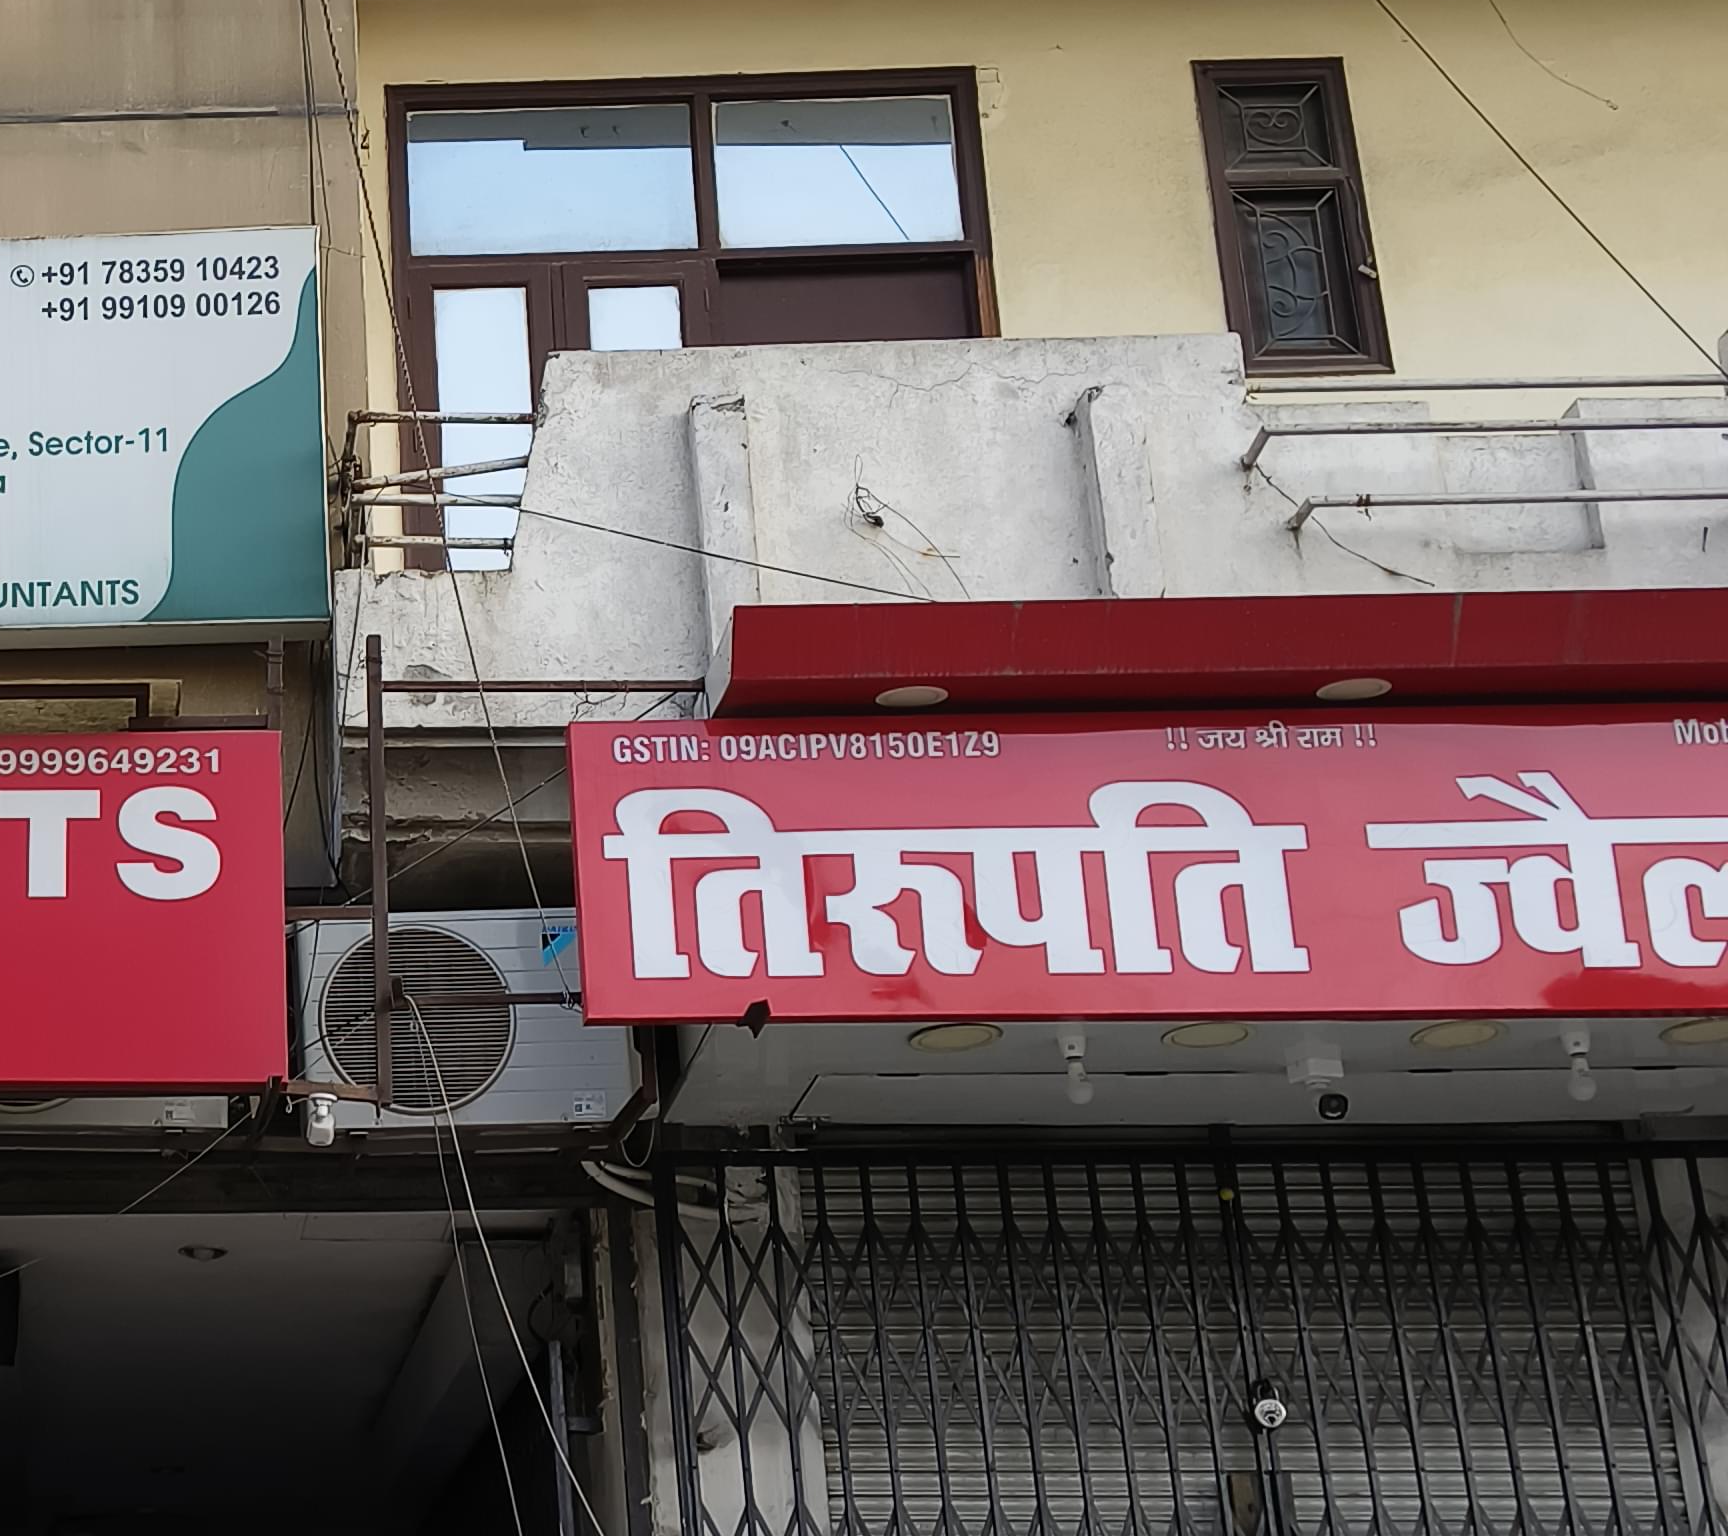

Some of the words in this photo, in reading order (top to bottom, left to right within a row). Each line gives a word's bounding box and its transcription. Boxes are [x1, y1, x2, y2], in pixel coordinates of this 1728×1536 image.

[40, 263, 90, 287] +91
[101, 259, 186, 284] 78359
[195, 256, 280, 281] 10423
[40, 298, 90, 322] +91
[101, 294, 186, 320] 99109
[195, 291, 281, 317] 00126
[28, 427, 168, 456] Sector-11
[613, 735, 711, 763] GSTIN:
